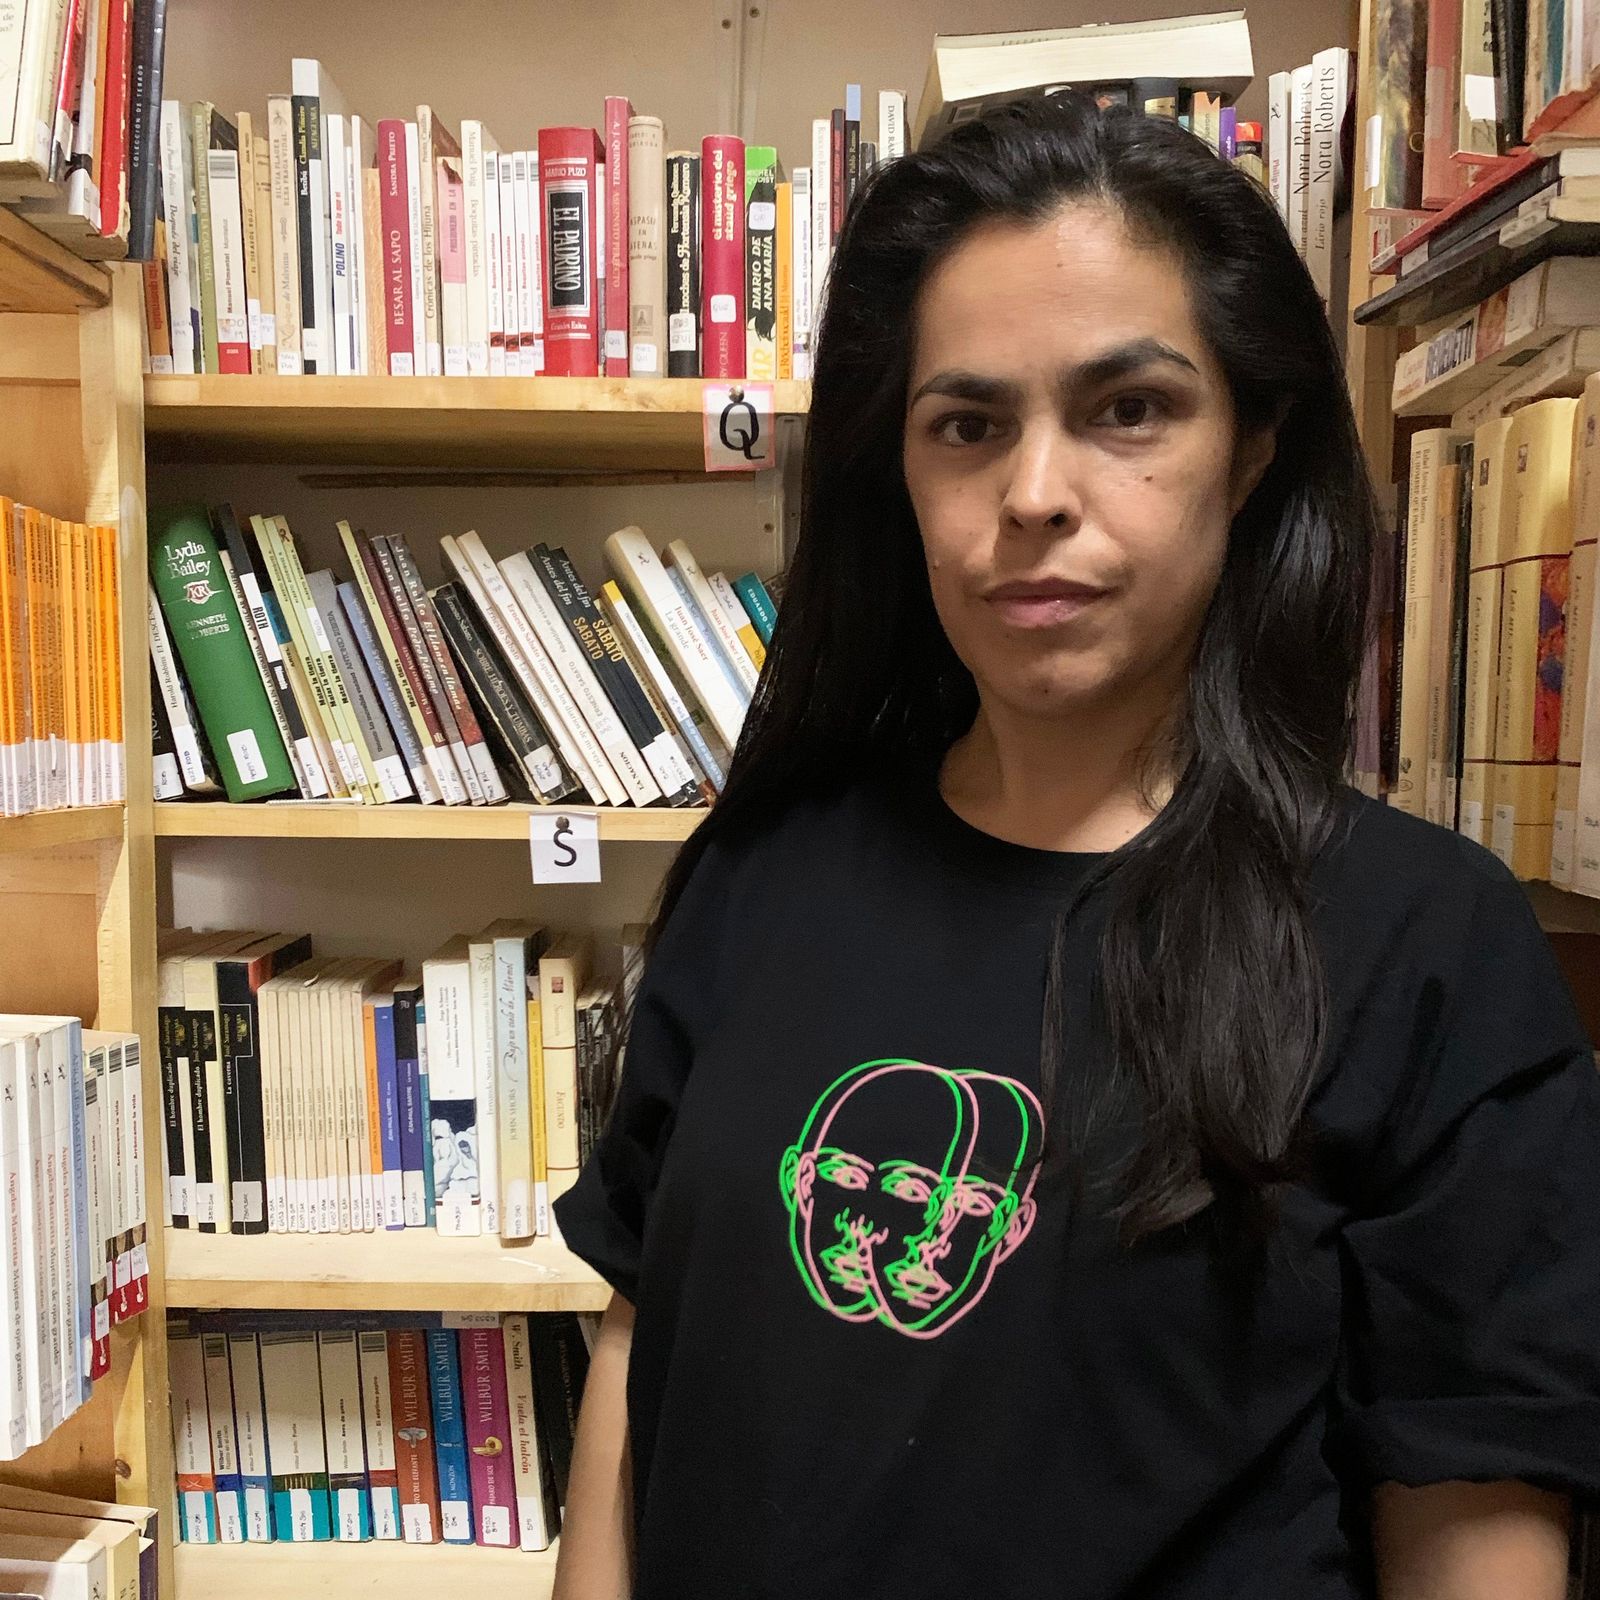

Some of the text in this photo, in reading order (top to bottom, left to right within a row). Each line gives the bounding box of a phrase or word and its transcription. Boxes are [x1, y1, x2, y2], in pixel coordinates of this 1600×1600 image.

[135, 102, 141, 112] DE
[1312, 66, 1336, 183] Nora Roberts
[298, 135, 306, 164] Claudia
[1293, 81, 1312, 194] Nora Roberts
[387, 131, 397, 196] SANDRA PRIETO
[545, 167, 587, 177] MARIO PUZO
[712, 150, 722, 169] del
[677, 163, 690, 204] Romero
[711, 171, 723, 226] misterio
[467, 132, 481, 277] Manuel Puig Boquitas pintadas
[1316, 198, 1327, 218] rojo
[172, 241, 180, 253] del
[677, 204, 690, 256] Hortensia
[335, 242, 345, 276] POLINO
[422, 241, 432, 255] los
[423, 259, 432, 271] de
[552, 206, 582, 291] EL PADRINO
[680, 258, 689, 270] de
[171, 256, 180, 276] viaje
[390, 230, 404, 324] BESAR AL SAPO
[751, 236, 761, 309] DIARIO DE
[762, 235, 772, 310] ANA MARÍA
[720, 401, 765, 460] Q
[165, 541, 206, 563] Lydia
[167, 559, 210, 579] Bailey
[393, 544, 412, 576] Juan
[407, 580, 428, 615] Rulfo
[539, 552, 605, 660] Antes del fin SABATO
[557, 556, 625, 663] Antes del fin SABATO
[746, 587, 769, 622] EDUARDO
[251, 605, 269, 630] ROTH
[377, 548, 440, 694] Juan Rulfo Pedro Páramo
[422, 619, 434, 633] El
[664, 609, 693, 649] La grande
[672, 604, 712, 661] Juan José Saer
[427, 632, 446, 662] Llano
[155, 642, 179, 708] Harold Robbins EL
[302, 655, 326, 706] Matar la tierra
[444, 674, 465, 710] llamas
[403, 687, 416, 708] Matar
[472, 647, 492, 673] SOBRE
[509, 710, 533, 742] TUMBAS
[618, 750, 644, 790] LA NACION
[553, 828, 577, 867] S
[166, 1062, 175, 1093] duplicado
[226, 1086, 231, 1094] La
[556, 1091, 566, 1128] FACUNDO
[509, 1118, 517, 1140] JOHN
[11, 1269, 21, 1310] Mujeres
[14, 1313, 21, 1324] de
[13, 1328, 21, 1349] ojos
[511, 1341, 524, 1369] Smith
[15, 1352, 23, 1391] grandes
[399, 1332, 418, 1421] WILBUR SMITH
[433, 1332, 454, 1421] WILBUR SMITH
[473, 1331, 493, 1422] WILBUR SMITH
[515, 1394, 528, 1424] Vuela
[518, 1426, 528, 1436] el
[519, 1439, 531, 1473] halcón
